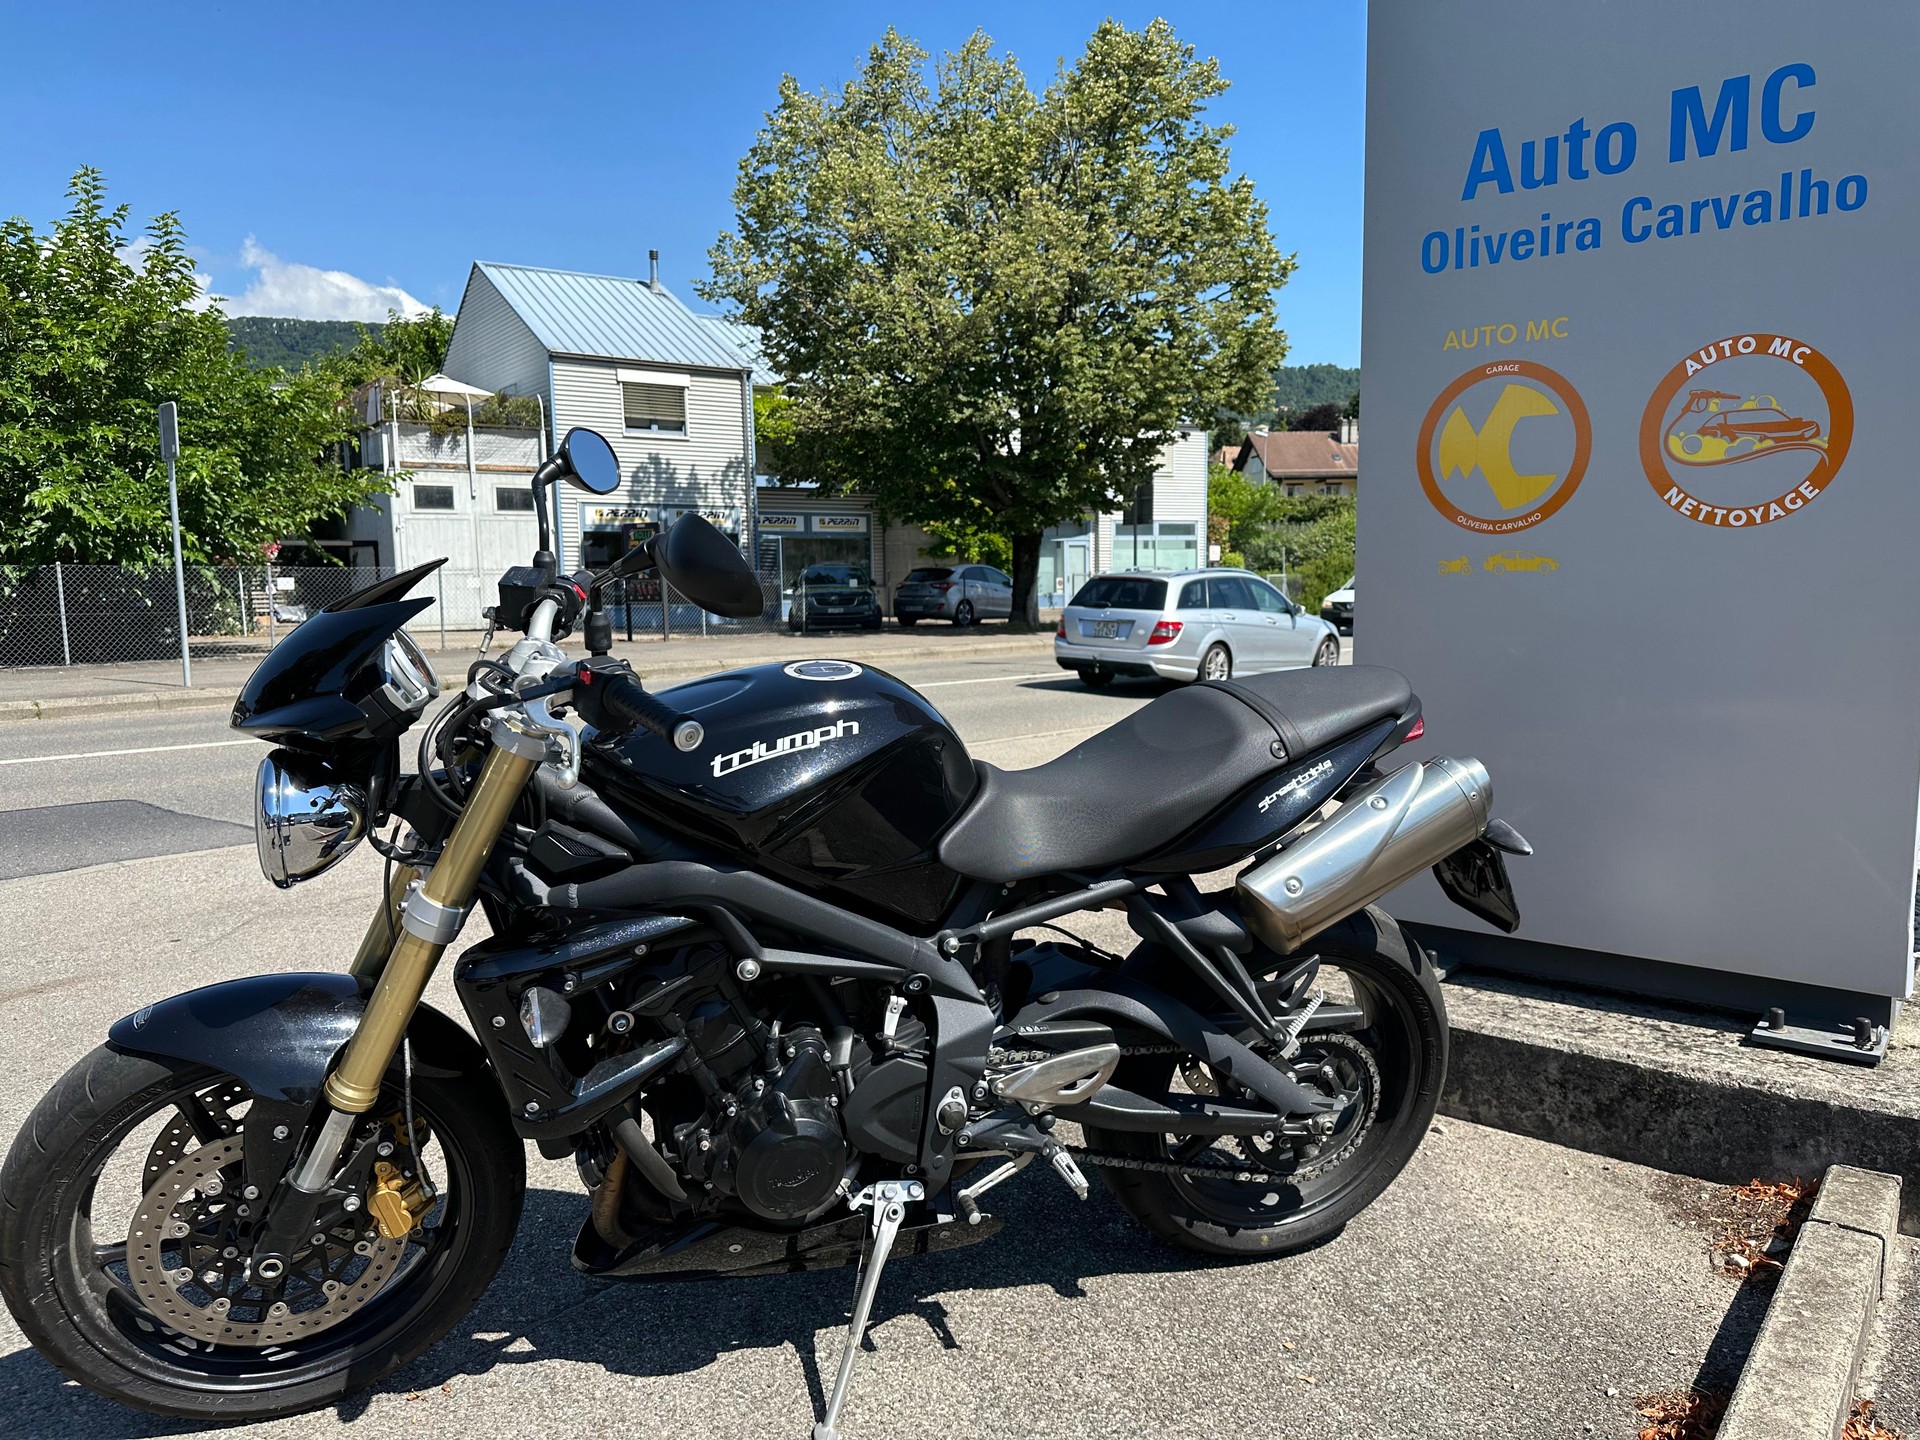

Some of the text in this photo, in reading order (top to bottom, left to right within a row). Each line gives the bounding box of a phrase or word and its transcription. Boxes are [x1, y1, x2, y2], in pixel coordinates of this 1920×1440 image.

[1461, 62, 1817, 201] Auto MC
[1421, 168, 1868, 274] Oliveira Carvalho
[1443, 316, 1569, 351] AUTO MC
[1486, 364, 1520, 374] GARAGE
[1684, 336, 1812, 377] AUTO MC
[1457, 512, 1542, 531] OLIVEIRA CARVALHO
[1663, 480, 1820, 527] NETTOYAGE
[710, 719, 859, 778] triumph
